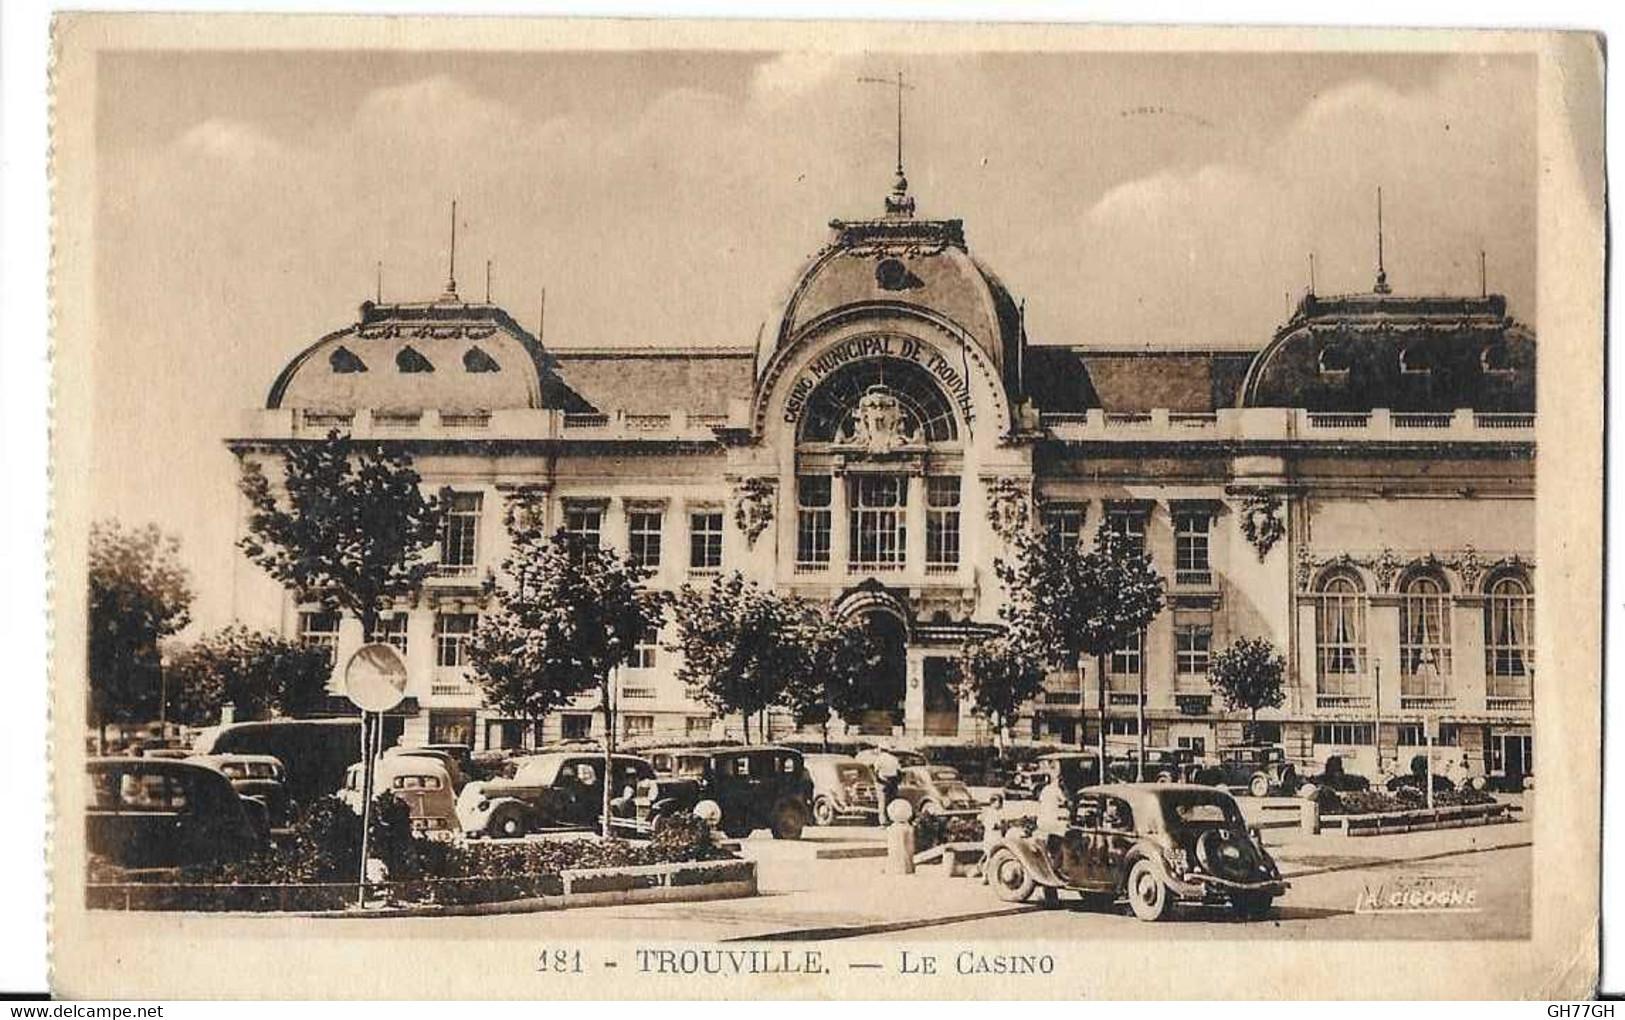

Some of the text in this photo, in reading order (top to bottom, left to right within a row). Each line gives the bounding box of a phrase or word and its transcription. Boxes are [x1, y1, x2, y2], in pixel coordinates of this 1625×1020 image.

[784, 337, 976, 423] CASINO MUNICIPAL DE TROUVILLE
